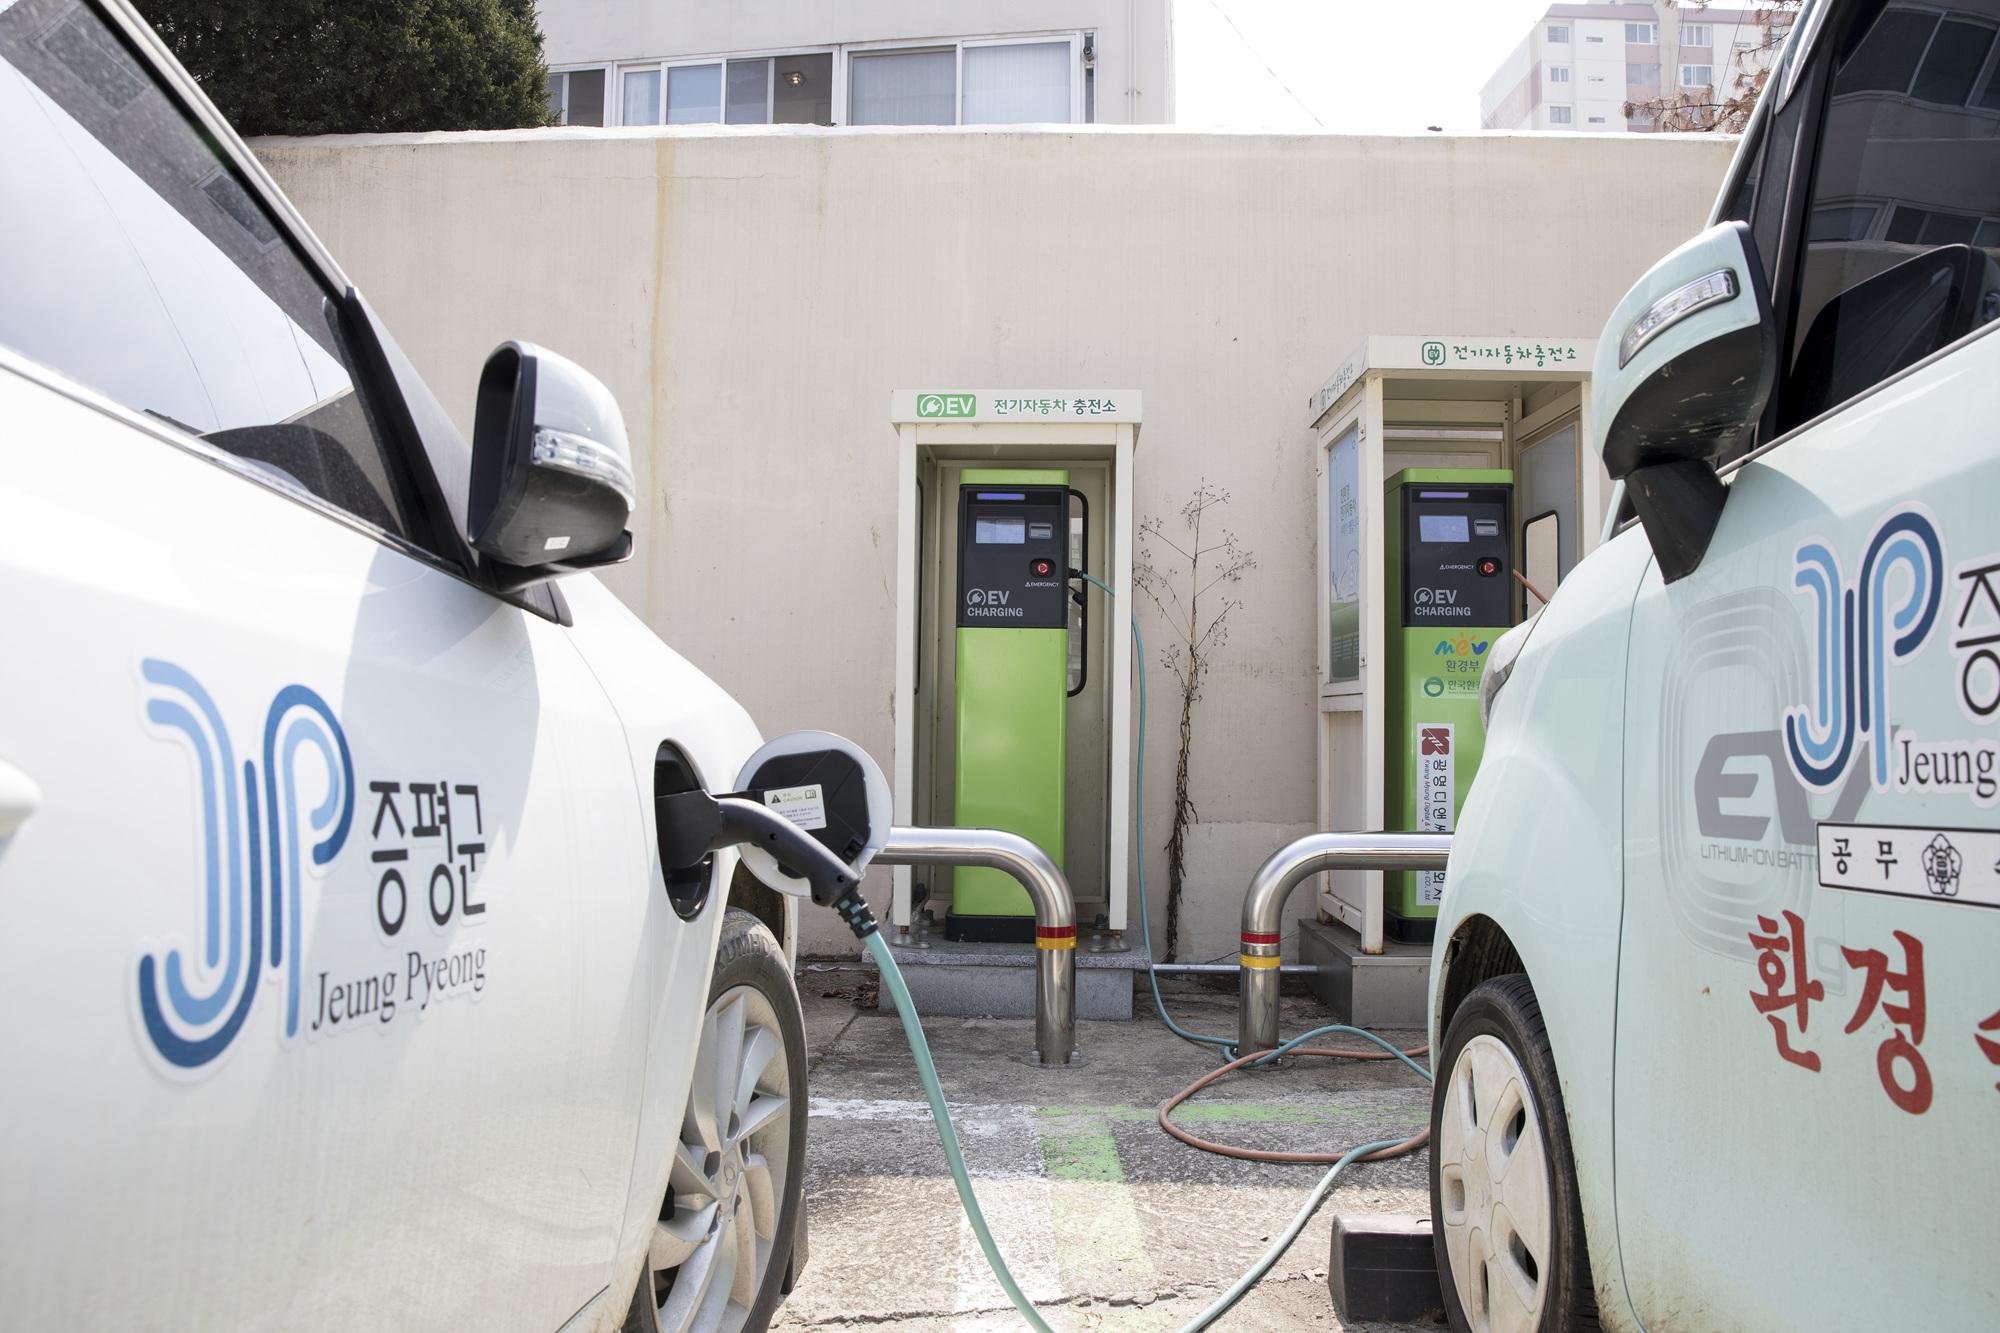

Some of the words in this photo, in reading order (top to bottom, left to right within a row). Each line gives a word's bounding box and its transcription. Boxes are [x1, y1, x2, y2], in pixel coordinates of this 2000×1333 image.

[1453, 344, 1577, 367] 전기자동차충전소
[946, 397, 974, 414] EV
[994, 398, 1067, 415] 전기자동차
[1072, 398, 1117, 415] 충전소
[987, 590, 1010, 605] EV
[1435, 589, 1458, 604] EV
[967, 607, 1024, 617] CHARGING
[1414, 606, 1472, 616] CHARGING
[1445, 659, 1480, 673] 환경부
[1899, 739, 1997, 799] Jeung
[369, 780, 486, 936] 증평군
[1700, 842, 1775, 867] LITHIUM-ION
[1778, 851, 1818, 871] BATT
[312, 969, 398, 1031] Jeung
[405, 947, 487, 1010] Pyeong
